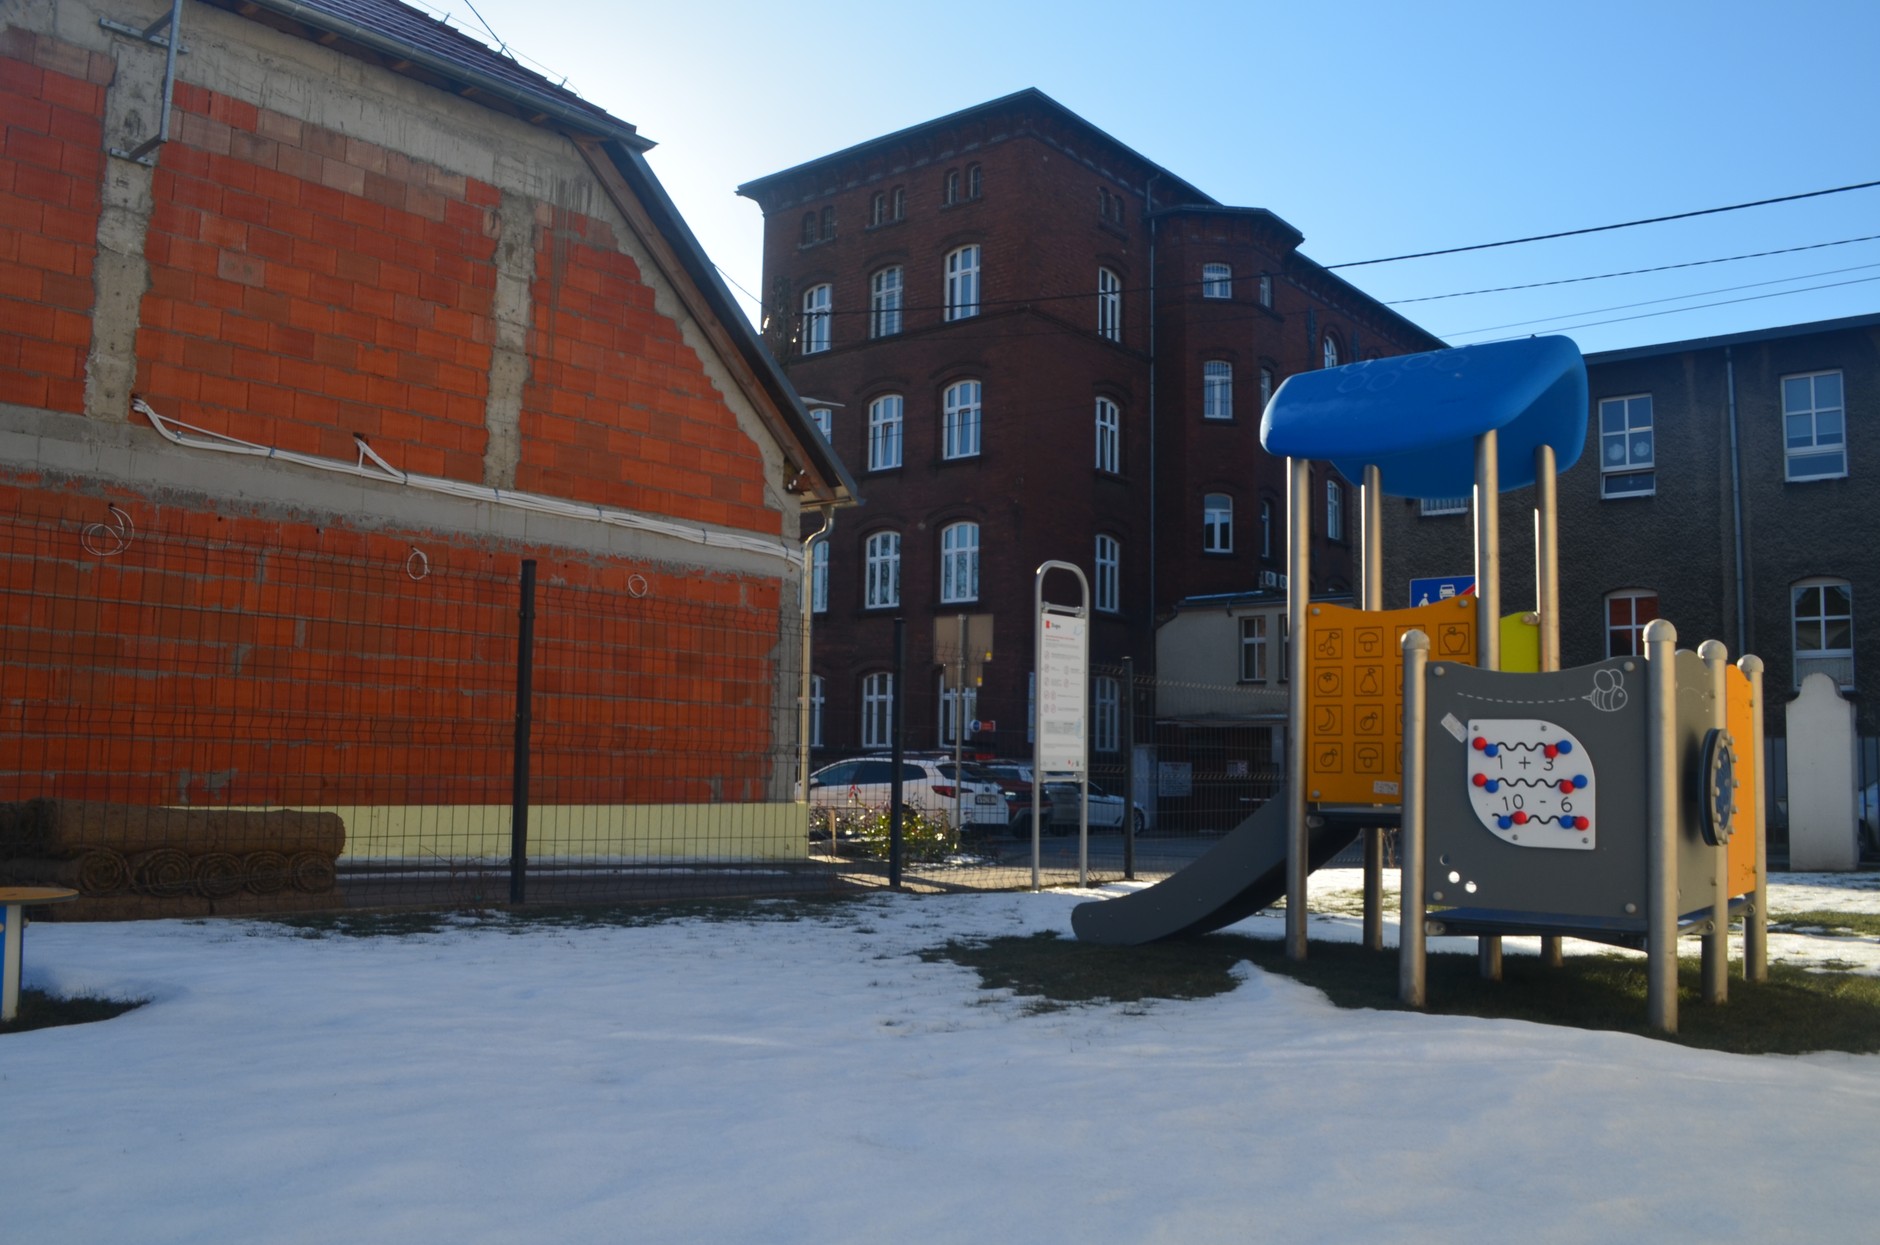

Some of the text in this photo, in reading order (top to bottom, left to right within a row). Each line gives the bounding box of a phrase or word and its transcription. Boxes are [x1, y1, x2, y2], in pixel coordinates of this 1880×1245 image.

[1497, 754, 1554, 771] 1 + 3
[1502, 793, 1524, 811] 10
[1560, 796, 1573, 813] 6
